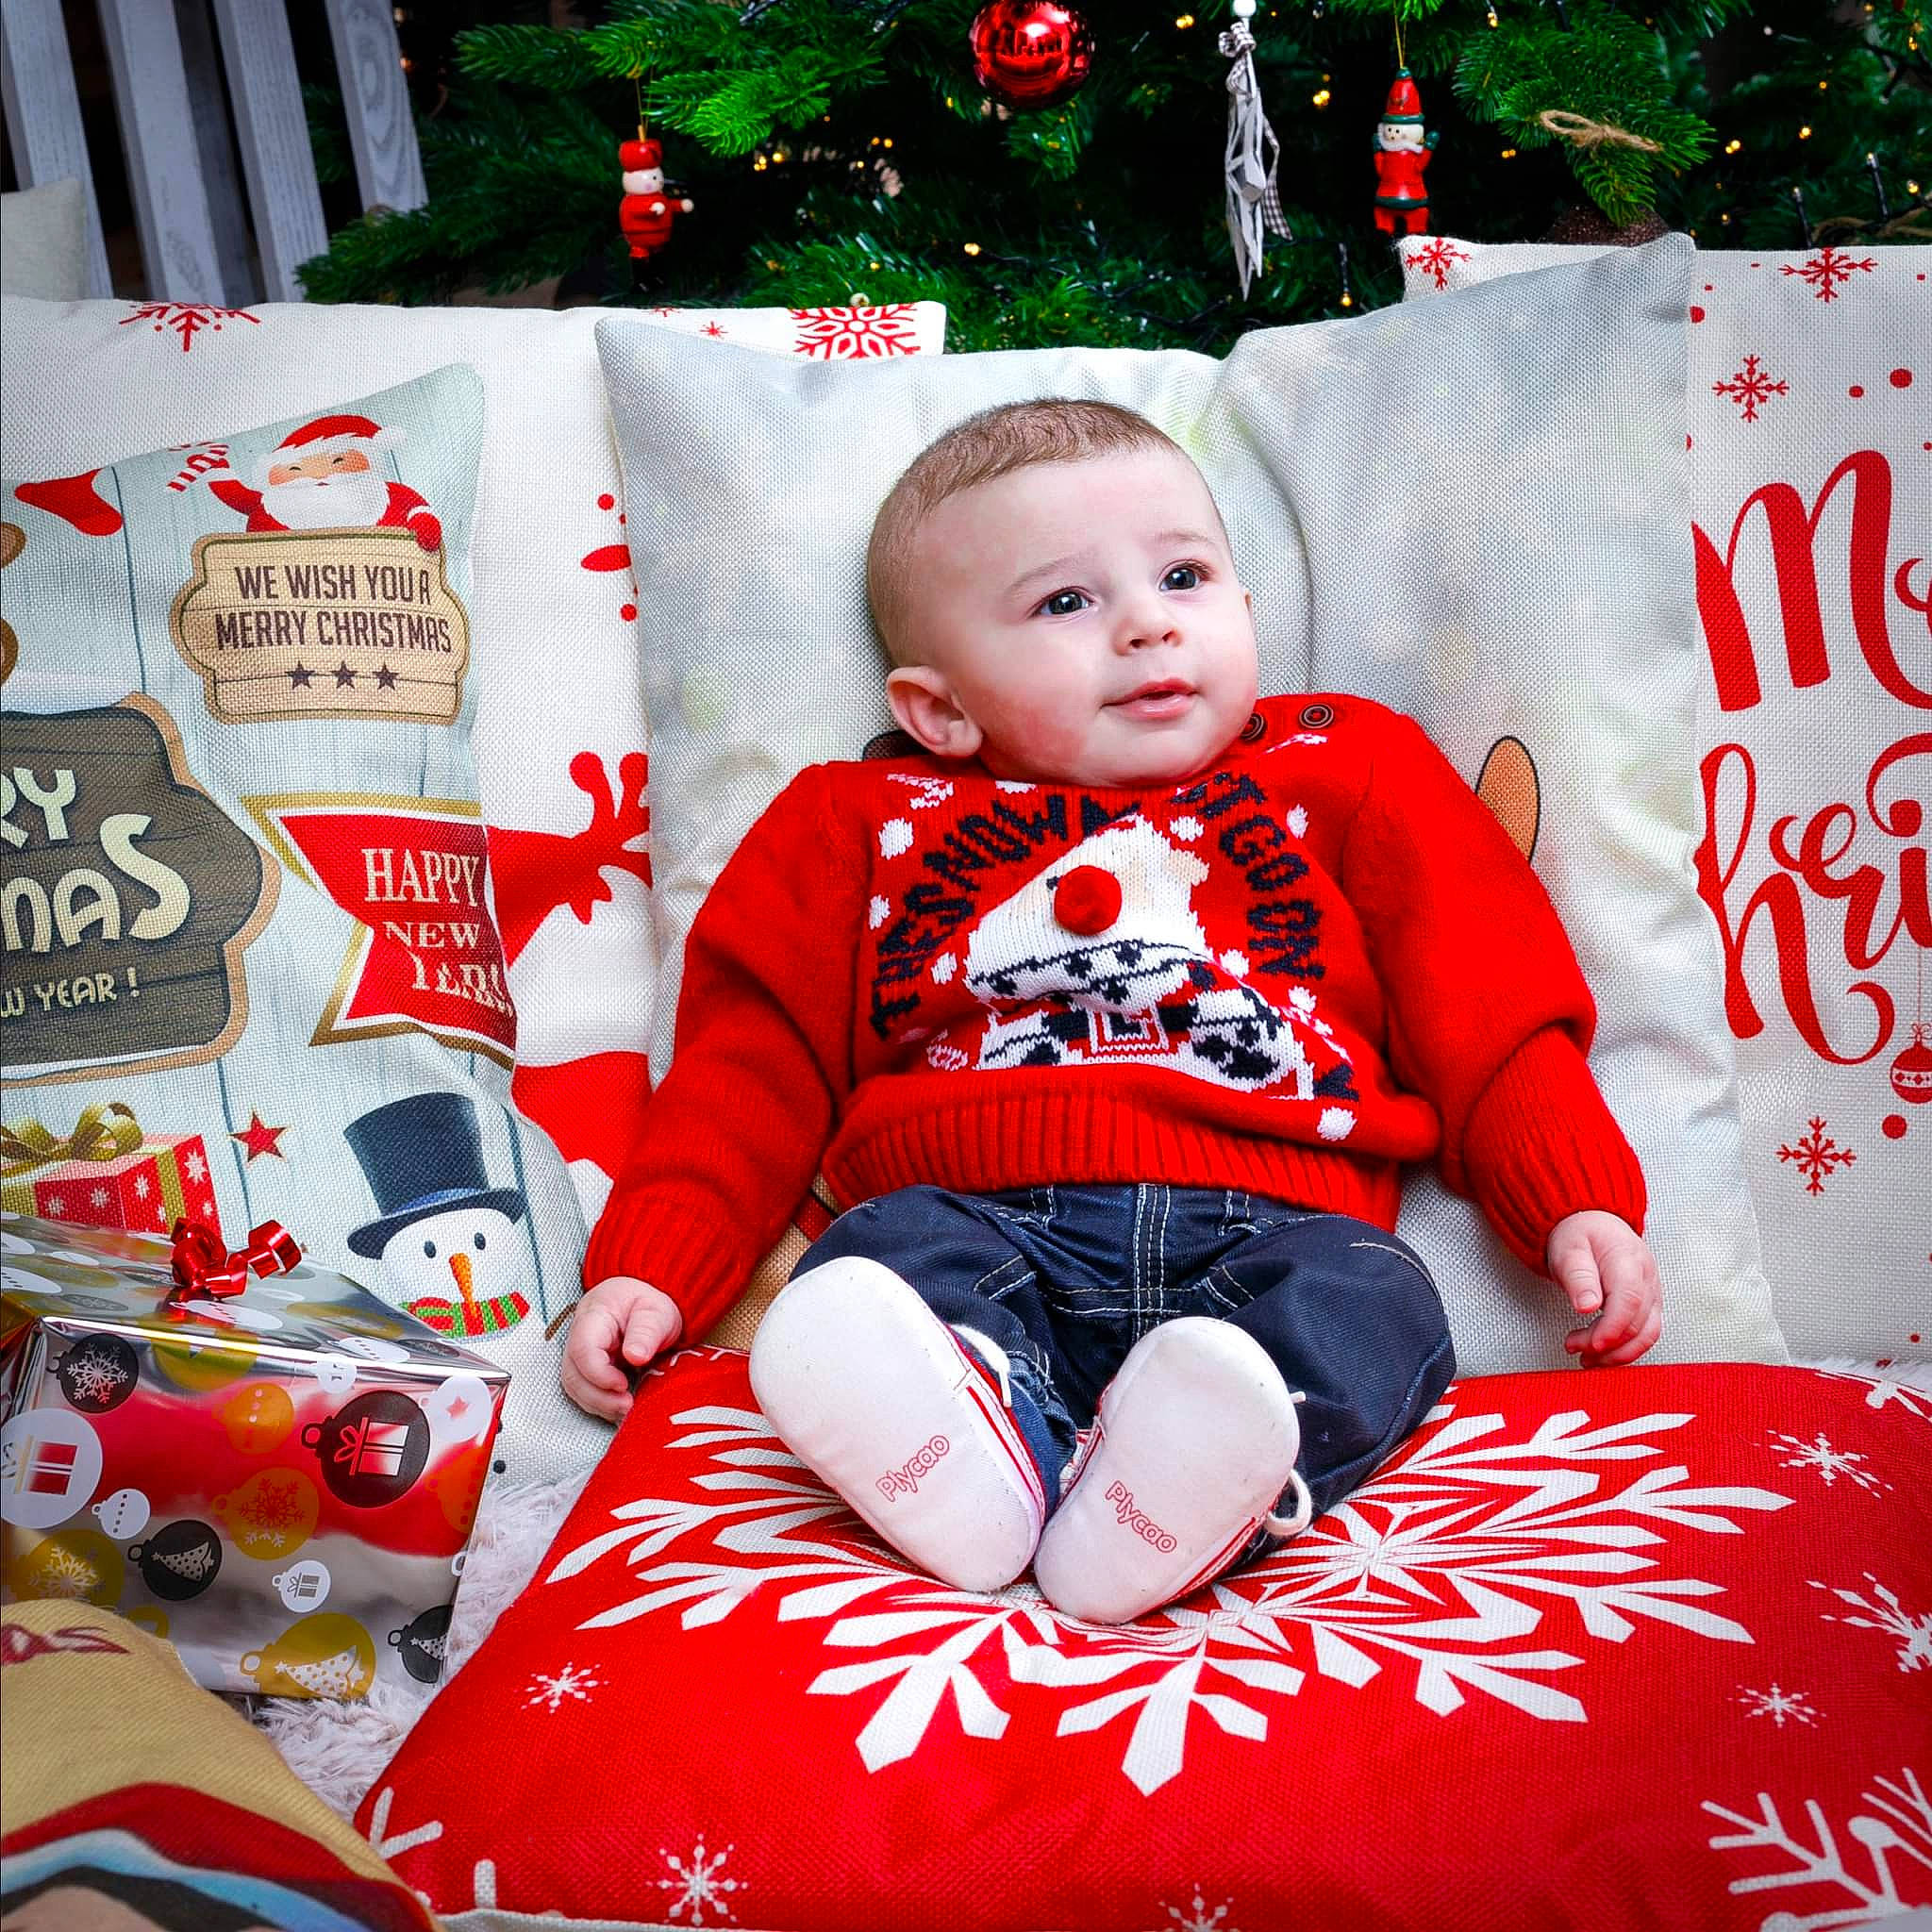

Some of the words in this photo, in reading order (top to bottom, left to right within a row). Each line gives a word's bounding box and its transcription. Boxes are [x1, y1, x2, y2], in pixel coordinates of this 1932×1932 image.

[235, 565, 279, 600] WE
[284, 565, 357, 600] WISH
[364, 565, 413, 603] YOU
[419, 569, 431, 605] A
[1691, 450, 1932, 712] M
[215, 610, 307, 650] MERRY
[317, 611, 452, 653] CHRISTMAS
[361, 847, 479, 907] HAPPY
[382, 921, 479, 948] NEW
[874, 1434, 950, 1503] Plycao
[1105, 1479, 1177, 1554] Plycao
